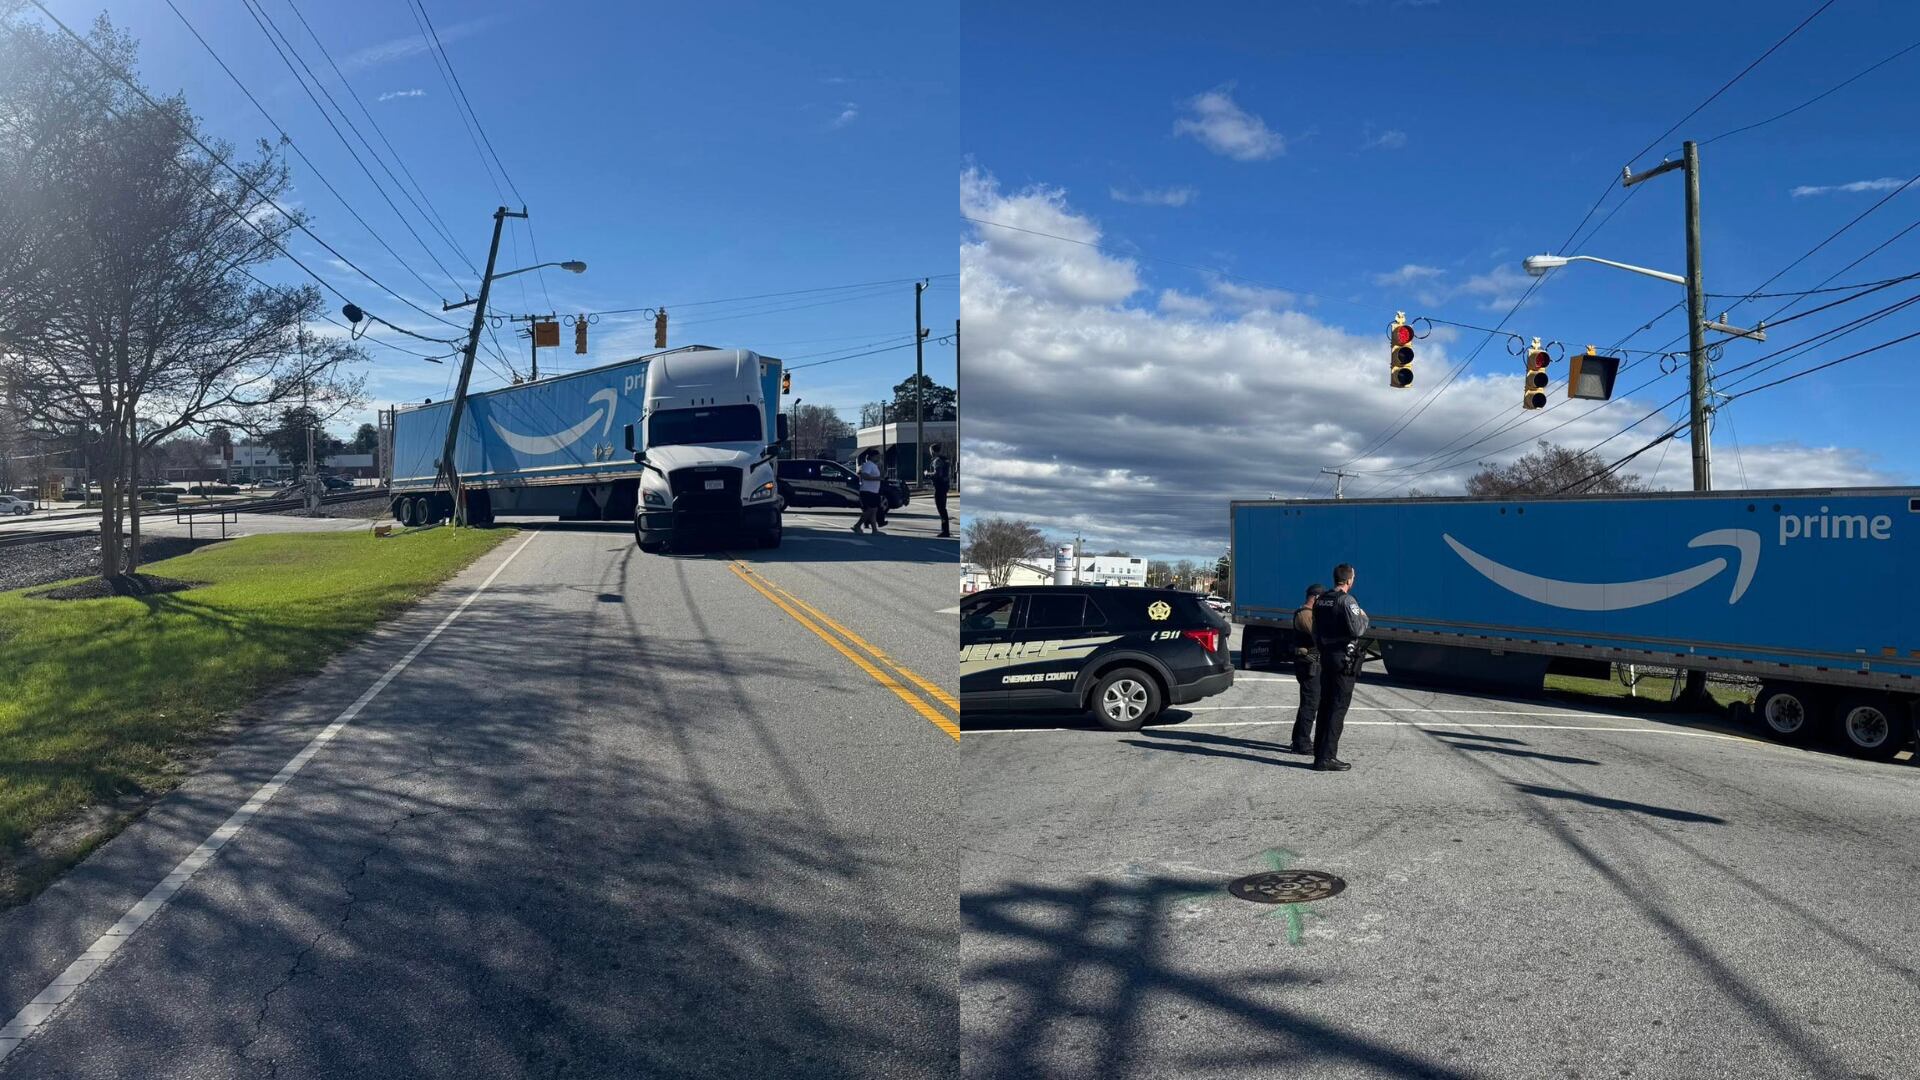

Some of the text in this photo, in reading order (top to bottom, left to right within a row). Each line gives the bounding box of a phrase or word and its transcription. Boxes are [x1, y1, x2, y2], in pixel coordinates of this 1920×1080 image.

[624, 367, 645, 396] pri
[1779, 505, 1892, 546] prime
[1159, 630, 1181, 640] 911
[1002, 671, 1079, 685] CHEROKEE COUNTY
